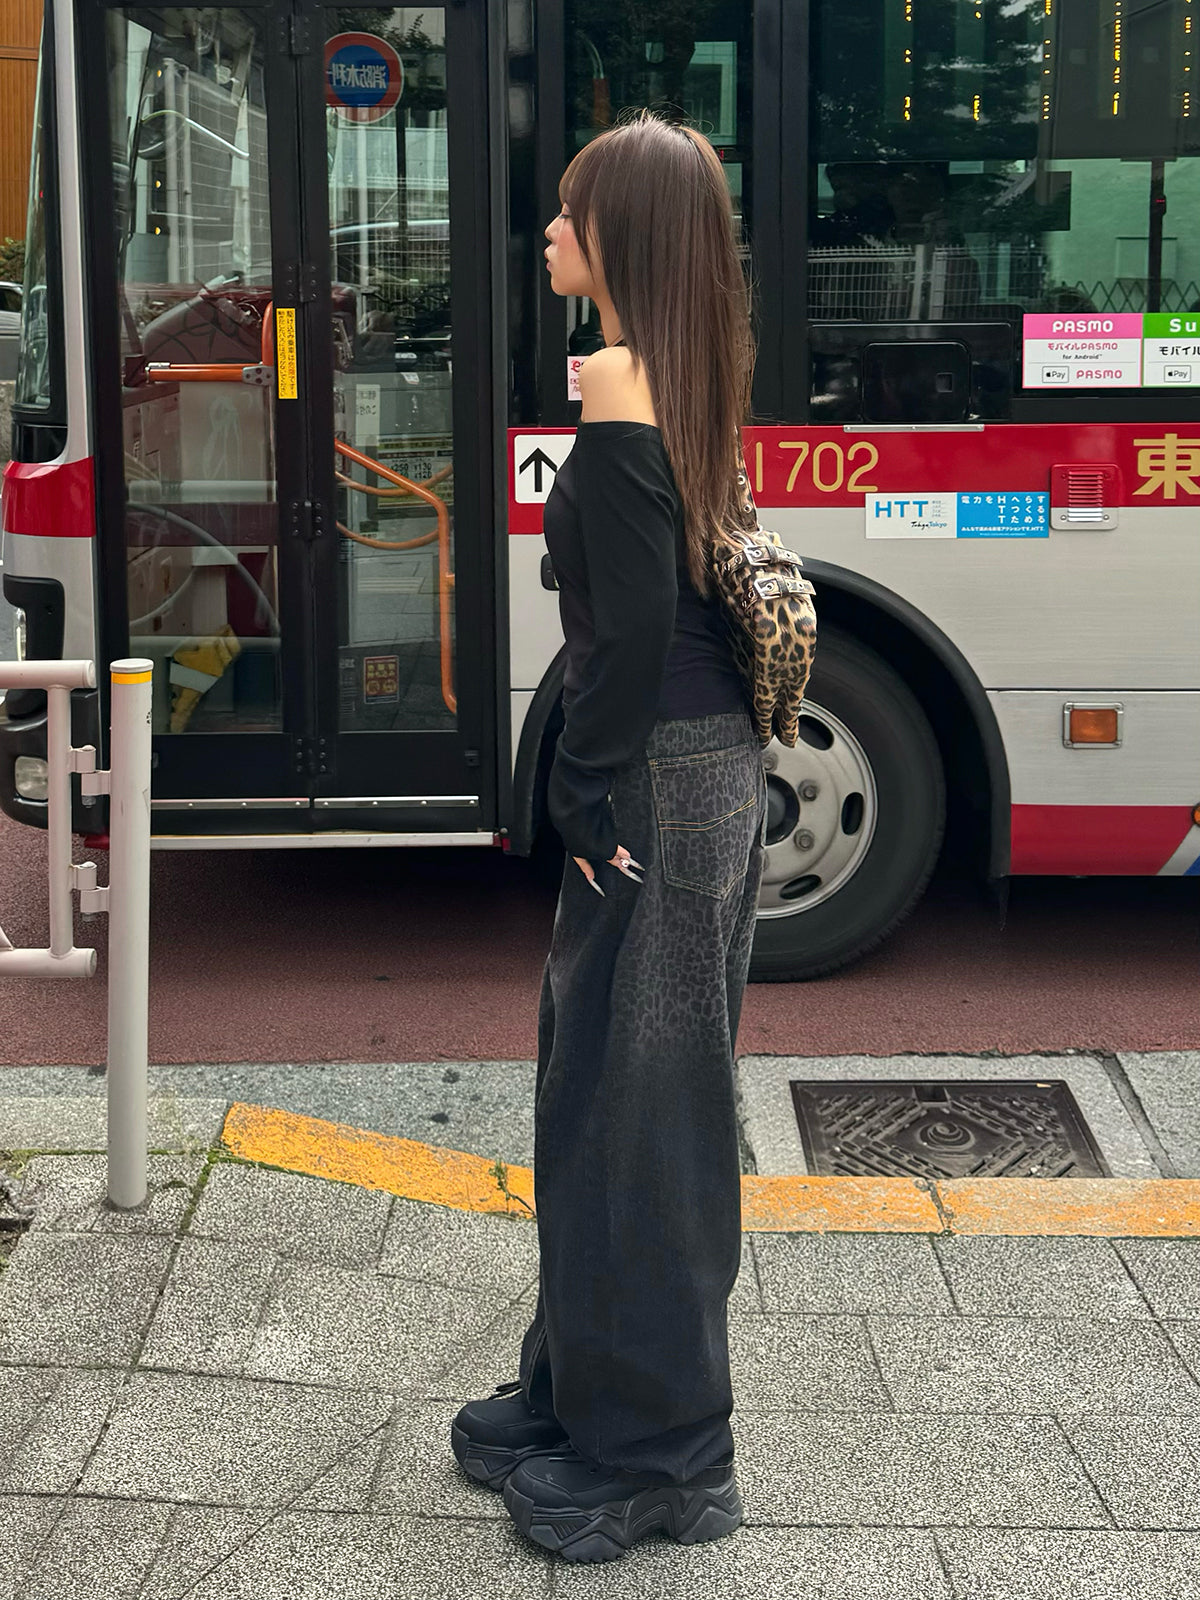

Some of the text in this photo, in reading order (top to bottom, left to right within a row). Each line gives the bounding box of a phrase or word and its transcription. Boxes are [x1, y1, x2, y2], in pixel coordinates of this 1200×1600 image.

[1052, 319, 1114, 333] PASMO
[1047, 342, 1118, 351] モバイルPASMO
[1159, 345, 1200, 356] モバイル
[1051, 369, 1123, 379] Pay PASMO
[1174, 370, 1188, 379] Pay
[755, 441, 879, 493] 1702
[1132, 433, 1200, 499] 東
[875, 500, 929, 518] HTT
